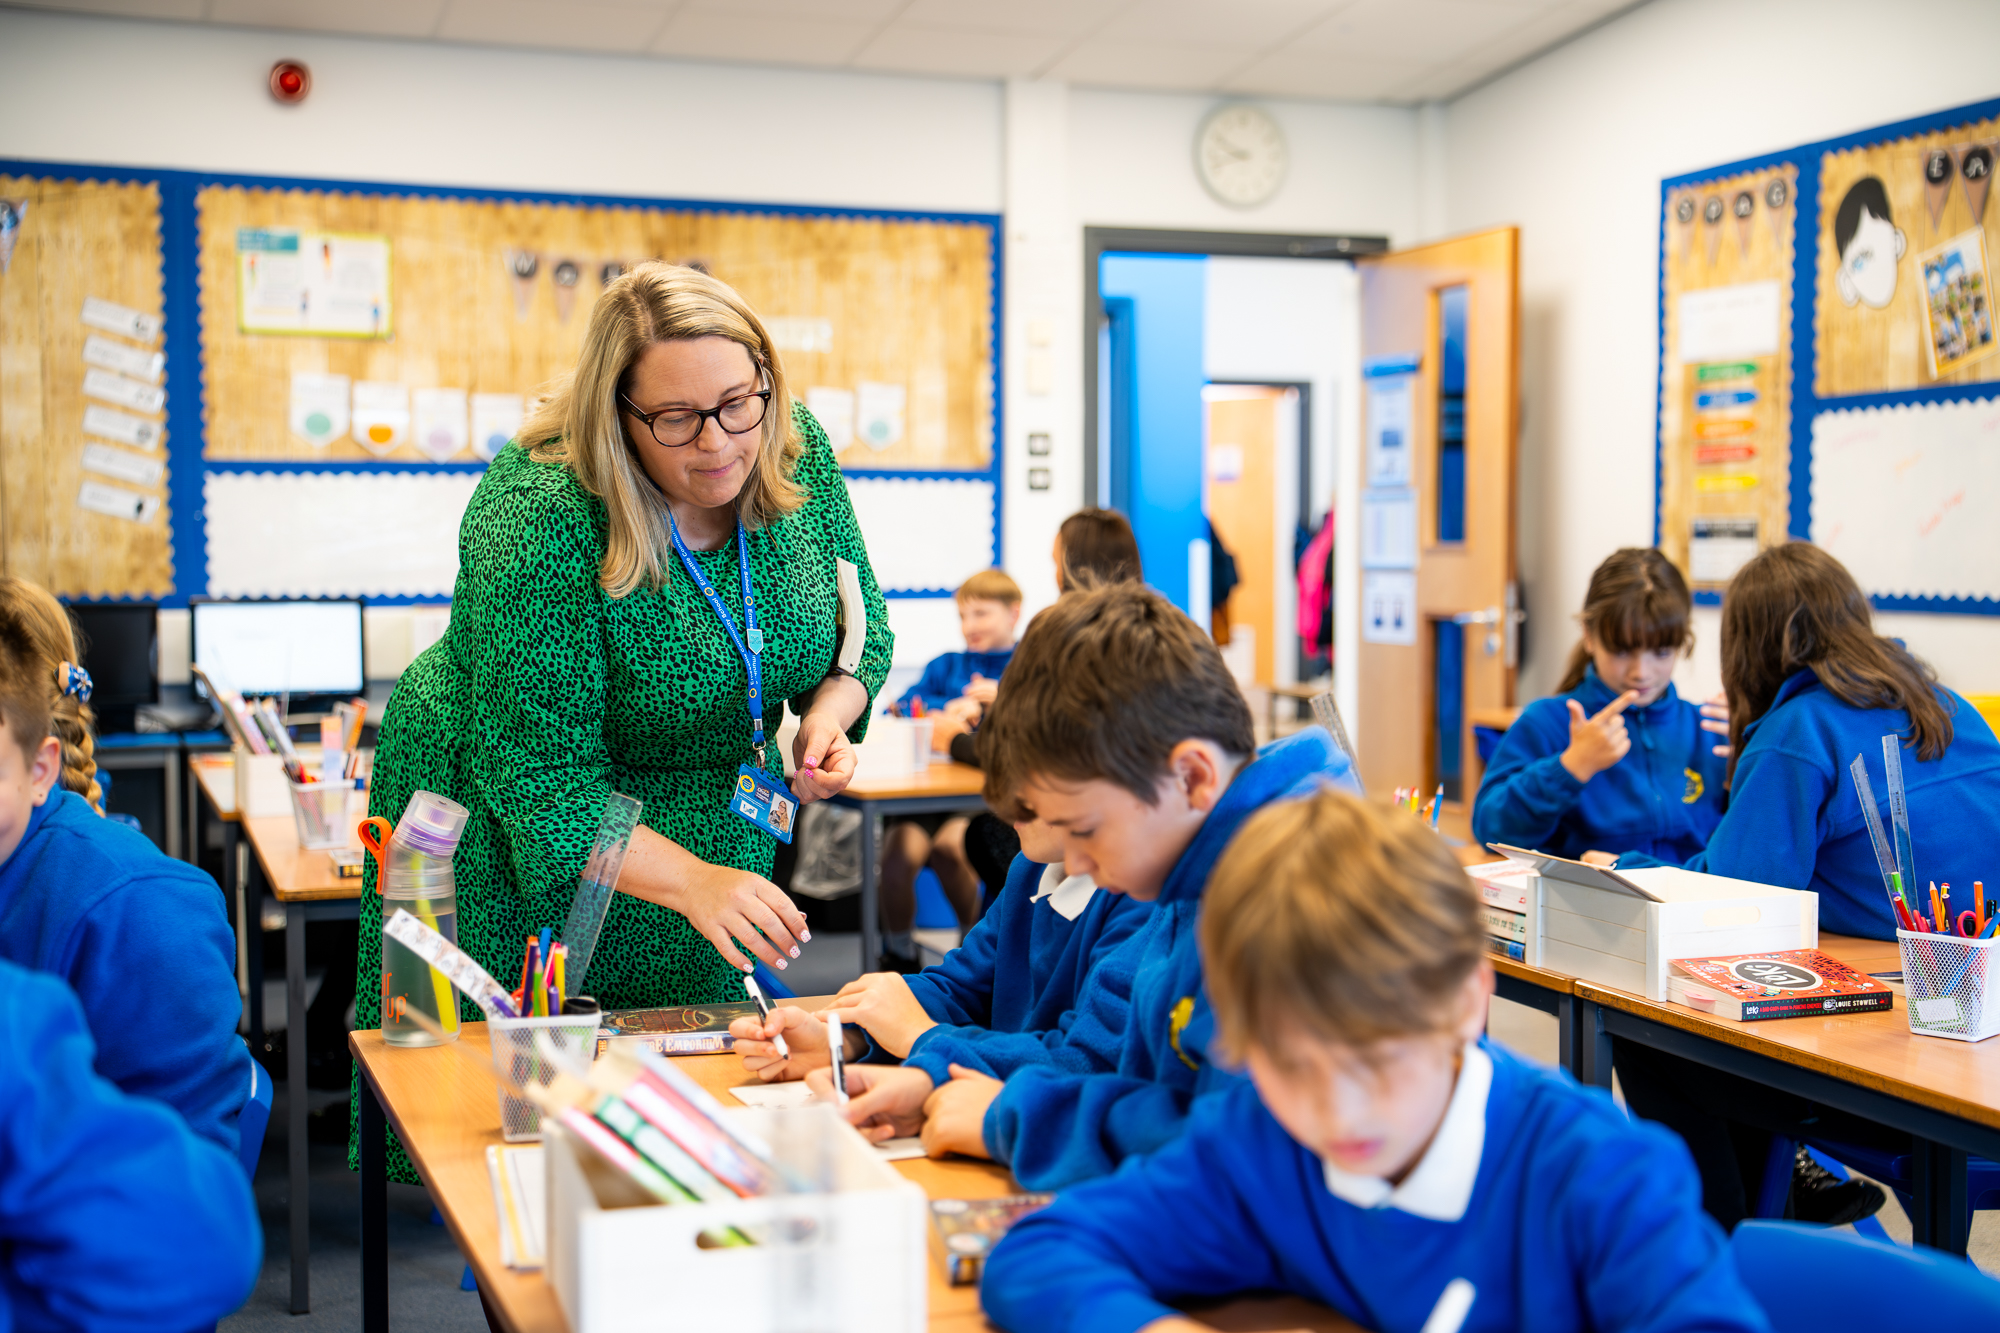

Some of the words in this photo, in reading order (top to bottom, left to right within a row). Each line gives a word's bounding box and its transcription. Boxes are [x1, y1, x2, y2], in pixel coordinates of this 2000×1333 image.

[711, 597, 727, 619] School
[386, 995, 407, 1024] up
[1835, 1000, 1852, 1008] LOUIE
[1852, 998, 1878, 1007] STOWELL
[665, 1034, 725, 1053] EMPORIUM
